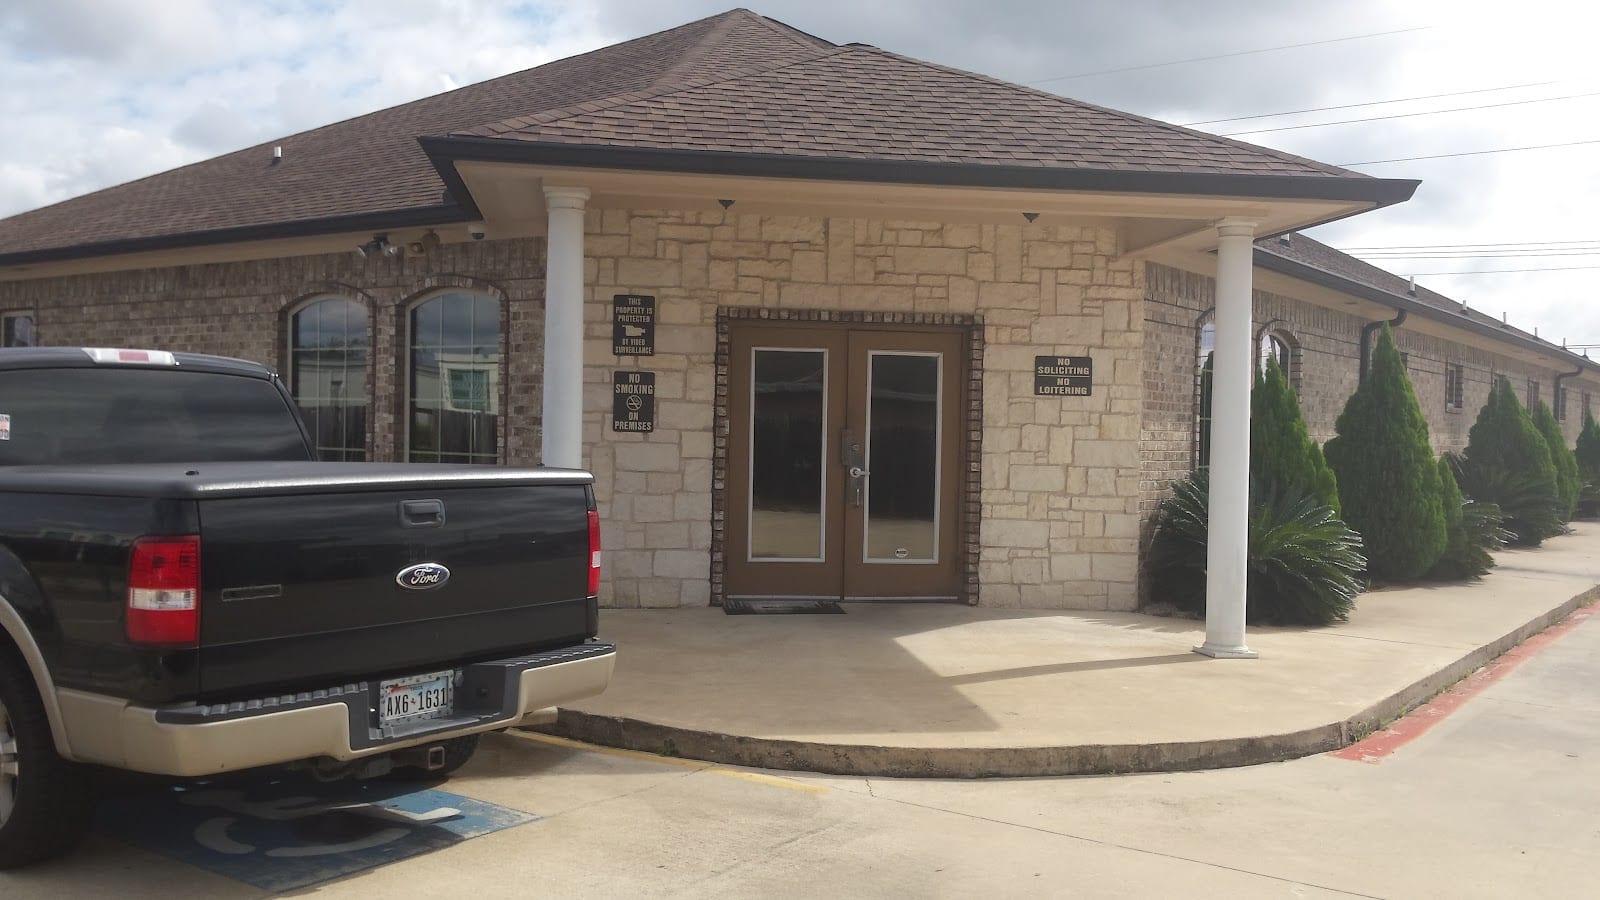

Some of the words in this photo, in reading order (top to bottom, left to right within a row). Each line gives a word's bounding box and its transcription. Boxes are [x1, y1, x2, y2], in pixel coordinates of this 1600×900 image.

[616, 306, 645, 315] PROPERTY
[646, 307, 653, 315] IS
[618, 315, 650, 323] PROTECTED
[630, 338, 646, 346] VIDEO
[615, 346, 652, 354] SURVEILLANCE
[1057, 358, 1070, 366] NO
[1038, 366, 1090, 375] SOLICITING
[628, 373, 641, 383] NO
[1056, 378, 1070, 386] NO
[615, 383, 653, 395] SMOKING
[1039, 386, 1087, 395] LOITERING
[628, 411, 639, 421] ON
[614, 421, 652, 431] PREMISES
[410, 568, 441, 585] Ford
[386, 694, 409, 717] AX6
[418, 687, 447, 711] 1631
